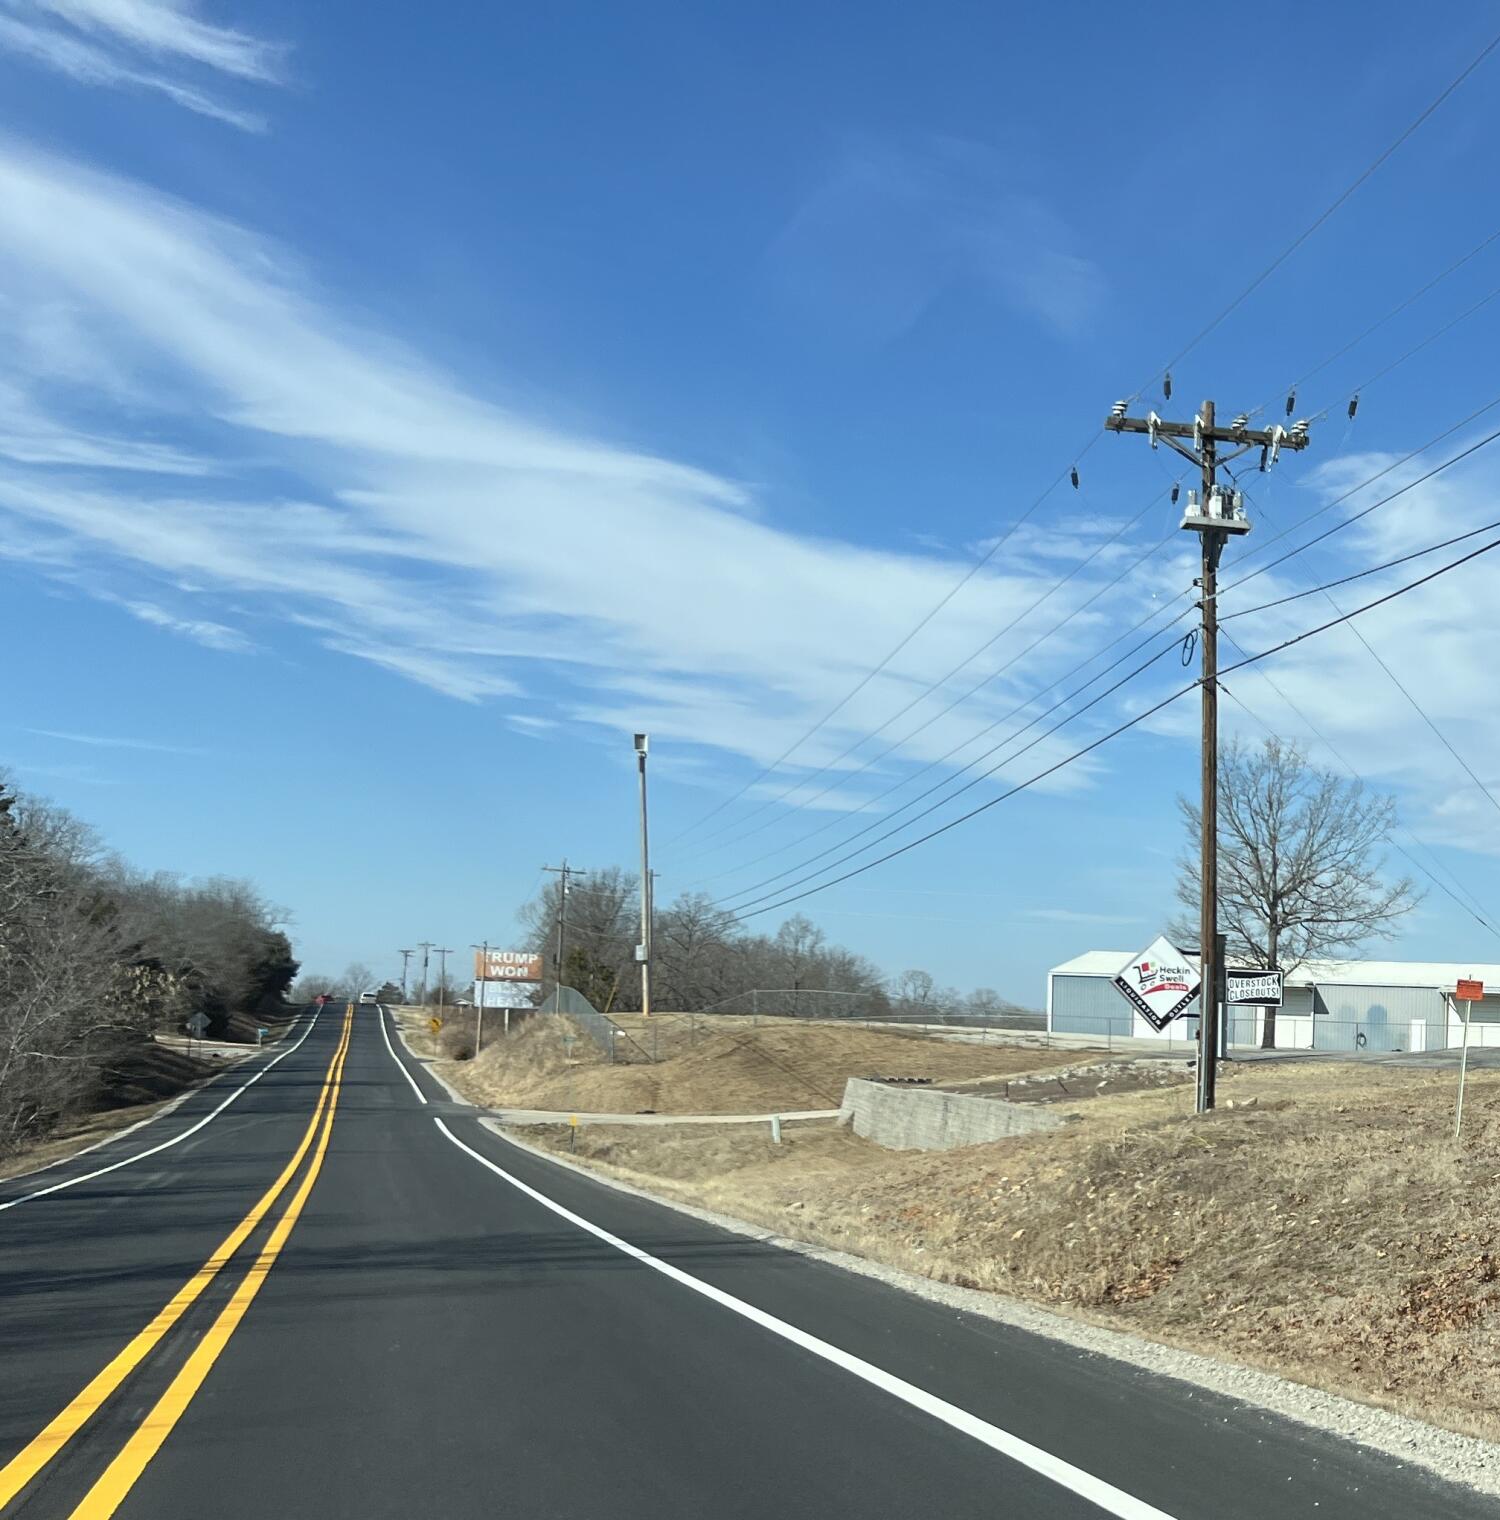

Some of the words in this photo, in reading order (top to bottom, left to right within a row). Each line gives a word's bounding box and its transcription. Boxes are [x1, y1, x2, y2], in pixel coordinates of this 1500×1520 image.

[480, 952, 538, 964] TRUMP
[490, 965, 529, 977] WON
[1159, 966, 1191, 975] Heckin
[1159, 975, 1184, 983] Swell
[1229, 976, 1278, 989] OVERSTOCK
[1164, 983, 1187, 991] Deals
[1229, 987, 1280, 1001] CLOSEOUTS!
[1118, 980, 1162, 1026] LIQUIDATION
[1168, 993, 1194, 1018] OUTLET
